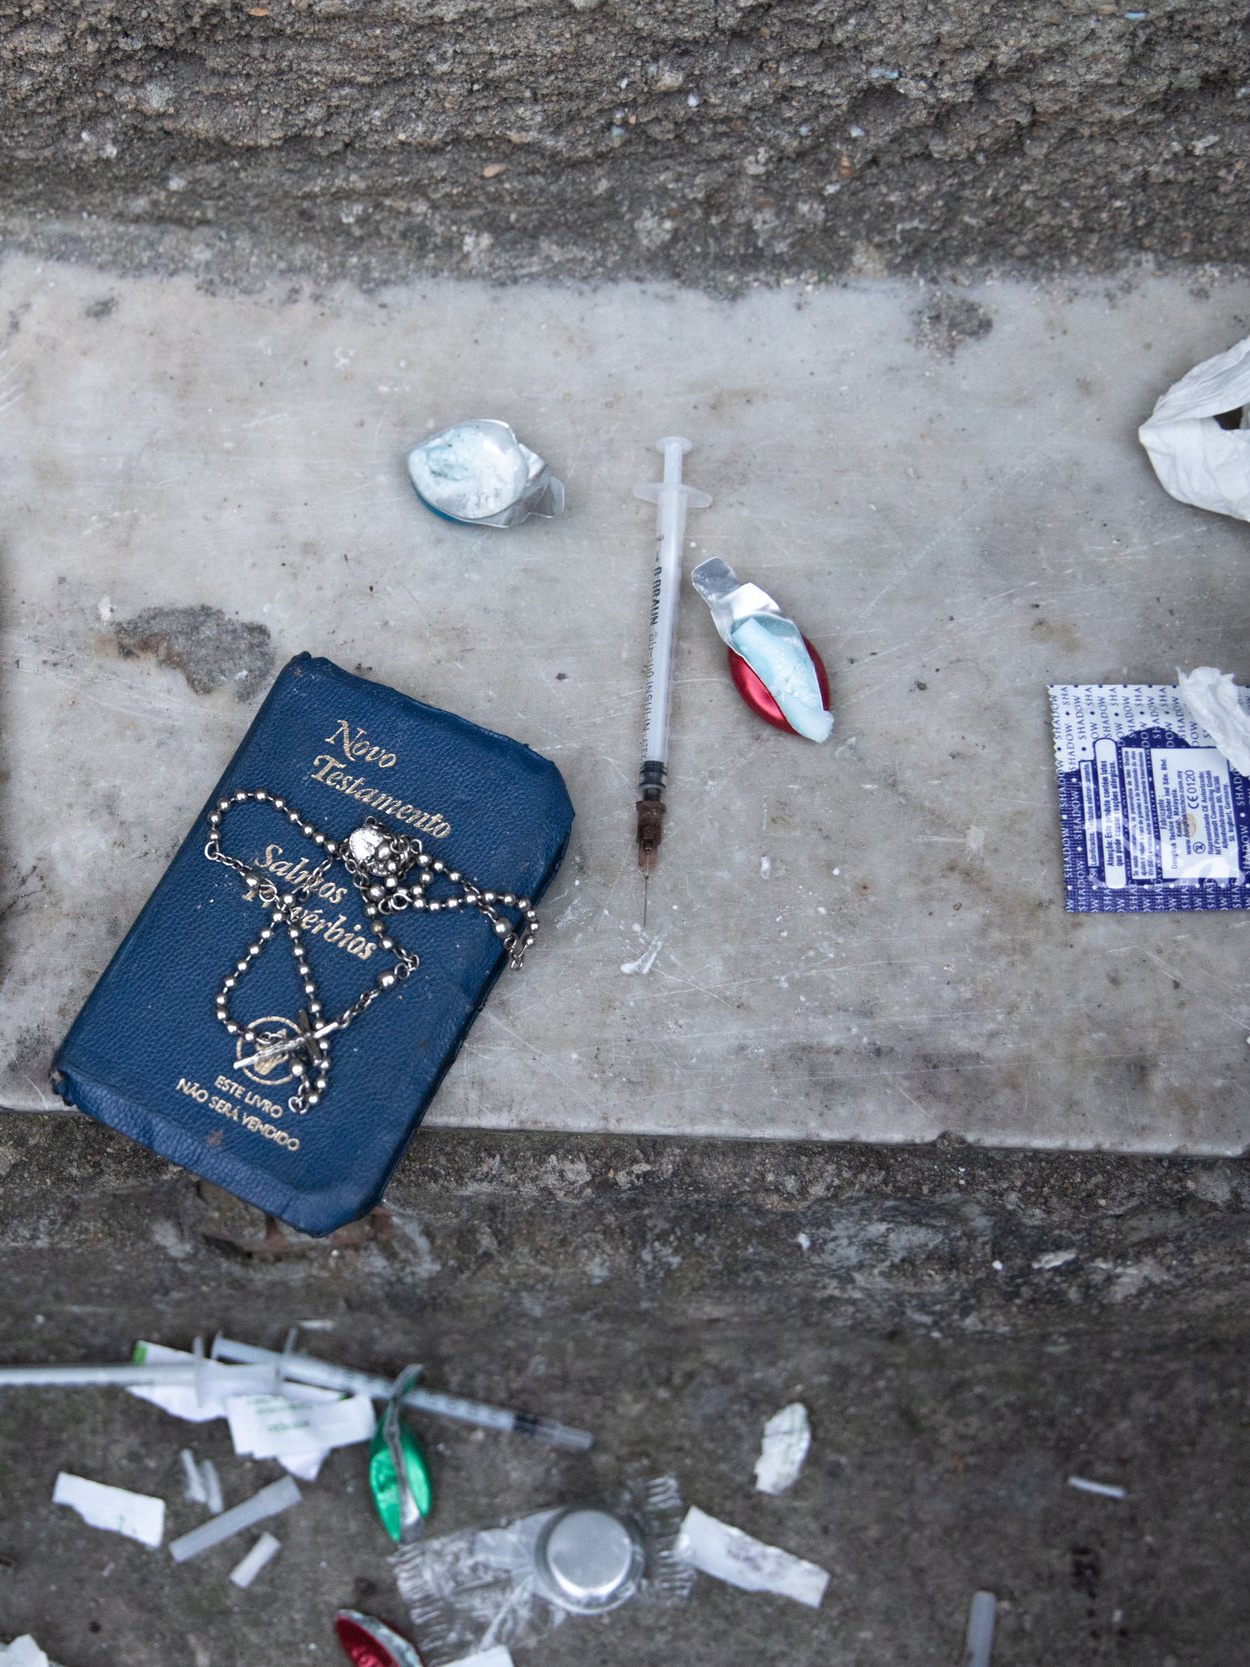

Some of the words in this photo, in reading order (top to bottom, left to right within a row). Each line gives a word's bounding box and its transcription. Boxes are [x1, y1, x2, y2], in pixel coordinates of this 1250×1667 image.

[1050, 694, 1062, 740] SHADOW
[1072, 694, 1086, 740] SHADOW
[1097, 696, 1112, 739] SHADOW
[1121, 696, 1137, 739] SHADOW
[1147, 696, 1162, 739] SHADOW
[1171, 696, 1187, 739] SHADOW
[324, 720, 397, 768] Novo
[1064, 723, 1076, 772] SHADOW
[310, 754, 452, 838] Testamento
[1055, 760, 1068, 808] SHADOW
[1101, 776, 1110, 798] contém
[1232, 767, 1246, 806] SHADO
[1070, 790, 1084, 840] SHADOW
[1157, 799, 1168, 830] Fabricante
[1165, 799, 1173, 819] Rubber
[1114, 839, 1124, 854] pode
[1168, 821, 1176, 841] Techco
[1104, 840, 1114, 866] Atenção:
[1116, 854, 1124, 866] que
[1076, 860, 1086, 911] SHADOW
[176, 1078, 209, 1102] NÃO
[208, 1096, 242, 1122] SERÁ
[242, 1112, 300, 1152] VENDIDO
[214, 1075, 246, 1099] ESTE
[244, 1091, 283, 1118] LIVRO
